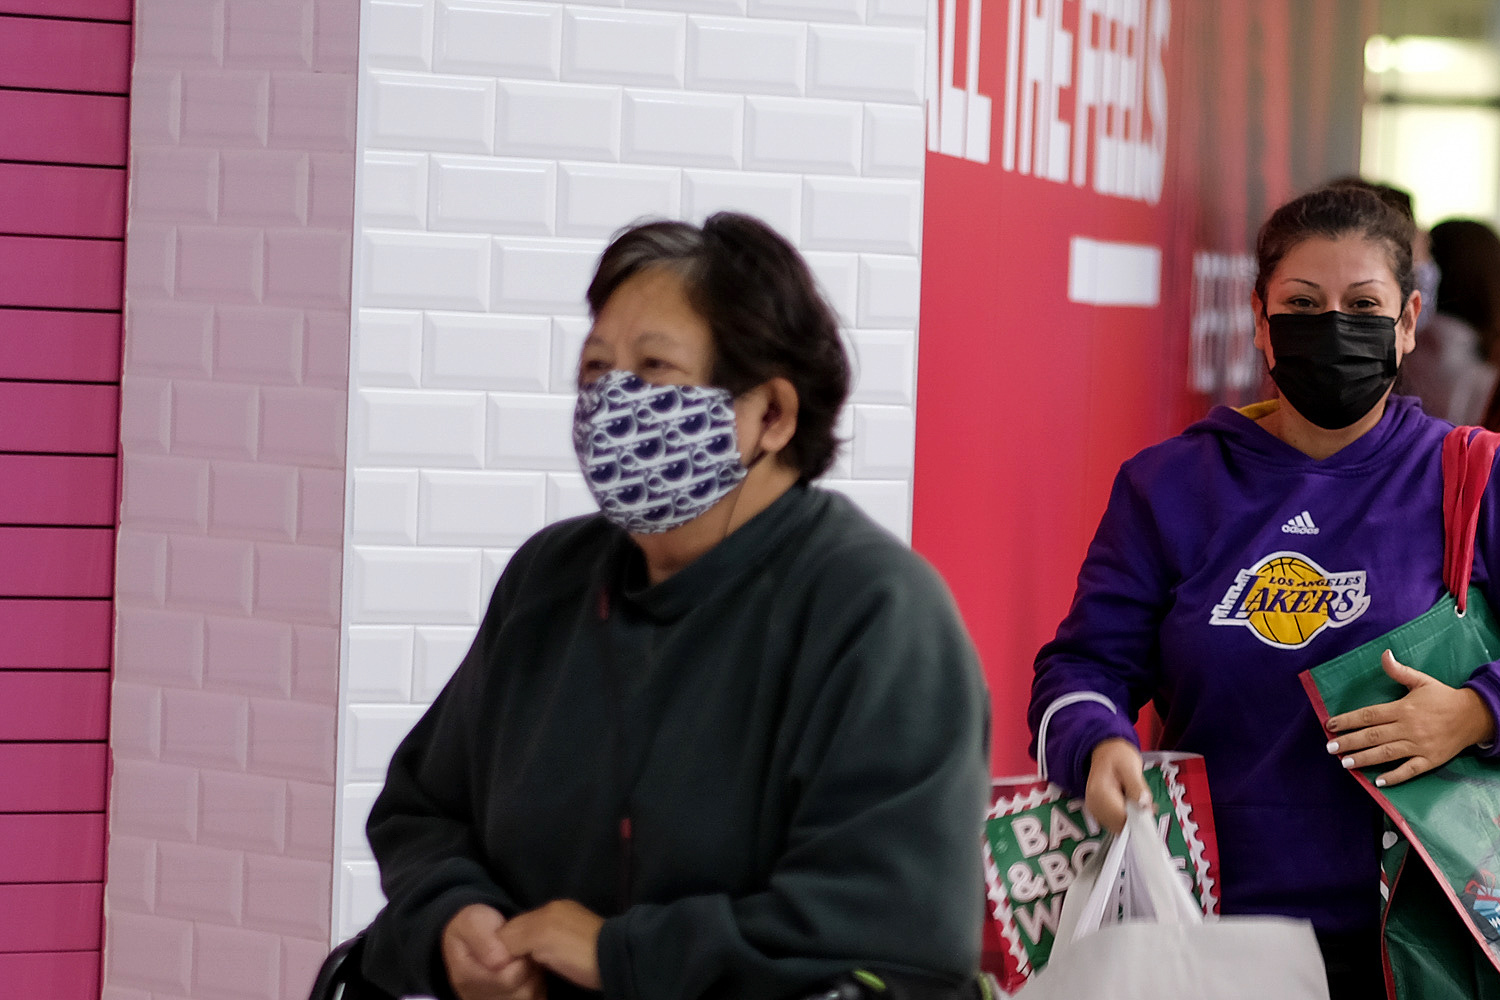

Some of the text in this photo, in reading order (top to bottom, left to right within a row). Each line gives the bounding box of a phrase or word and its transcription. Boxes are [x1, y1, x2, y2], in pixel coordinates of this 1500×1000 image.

[1281, 524, 1320, 535] adidas
[1268, 575, 1362, 588] LOS ANGELES
[1227, 573, 1362, 622] LAKERS
[1011, 799, 1101, 858] BAT
